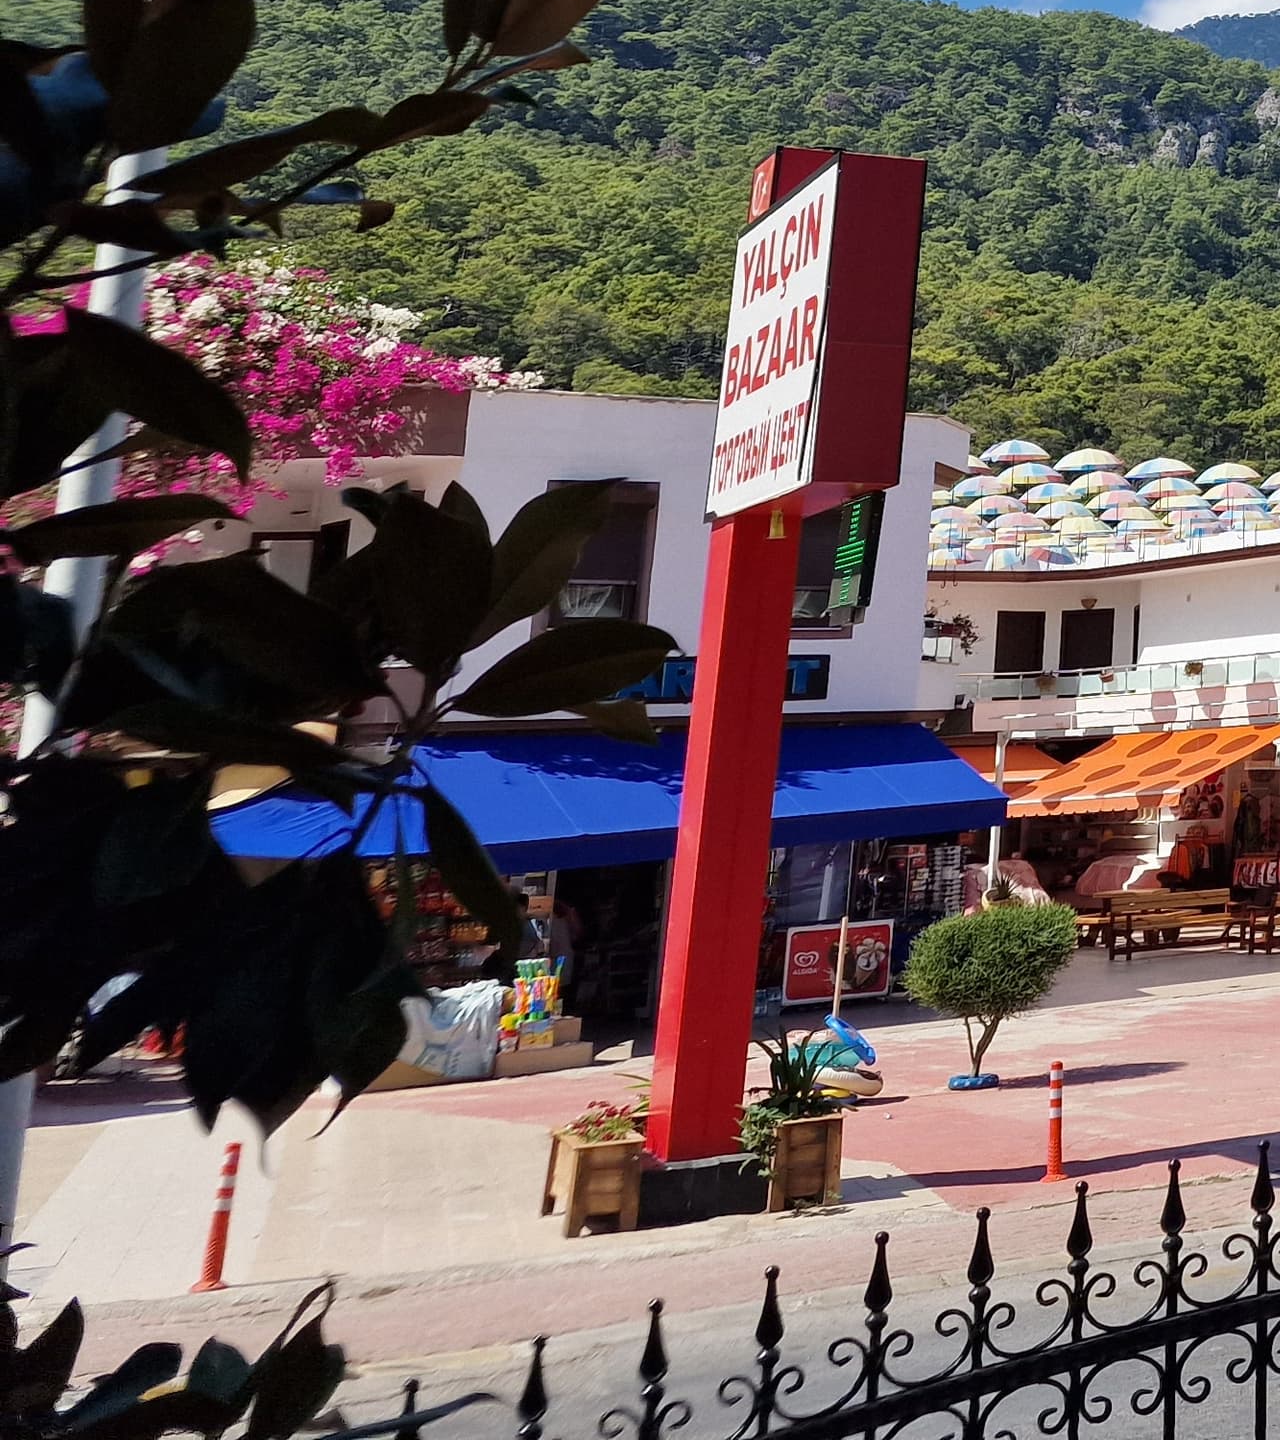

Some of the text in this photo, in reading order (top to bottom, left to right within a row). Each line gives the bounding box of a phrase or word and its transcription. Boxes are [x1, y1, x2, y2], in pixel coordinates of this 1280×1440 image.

[742, 193, 824, 309] YALÇIN
[724, 295, 818, 408] BAZAAR
[770, 399, 810, 481] ЦЕНТ
